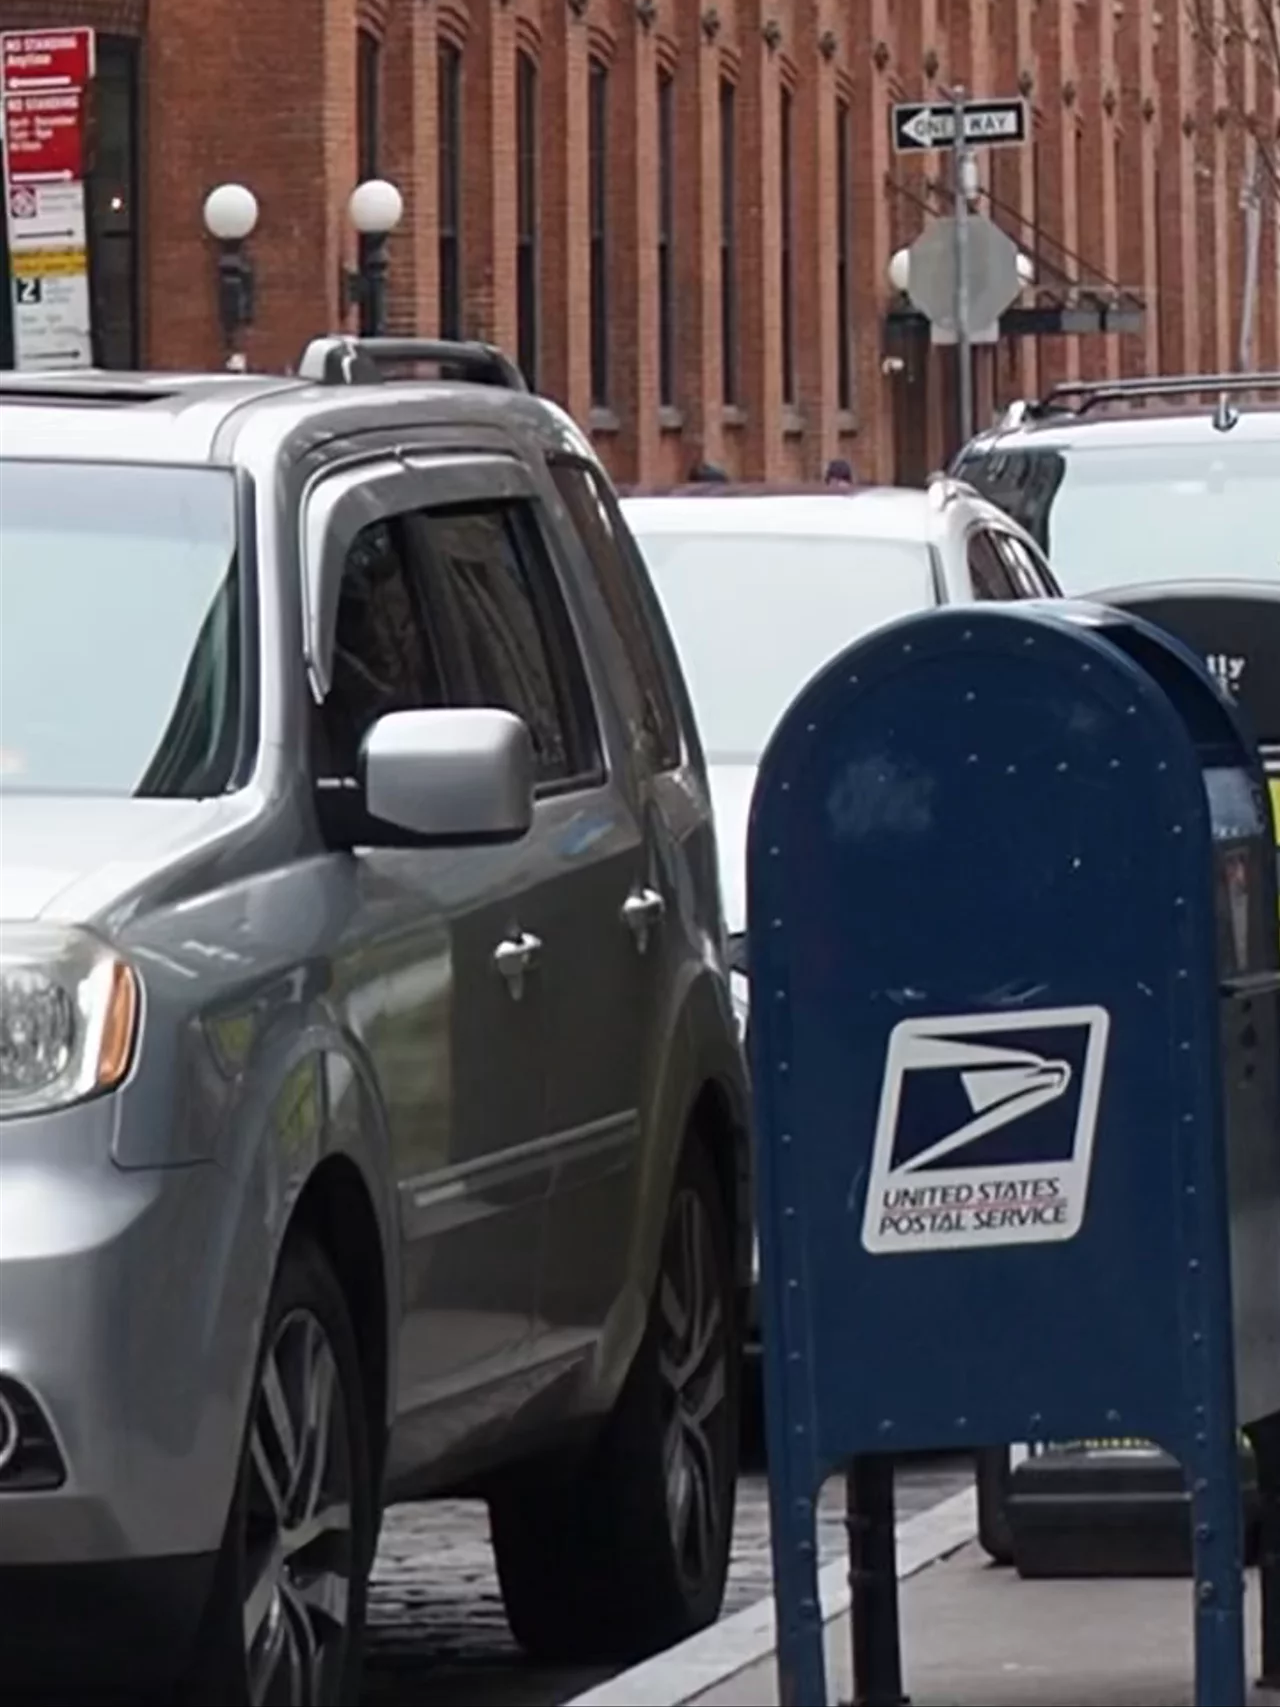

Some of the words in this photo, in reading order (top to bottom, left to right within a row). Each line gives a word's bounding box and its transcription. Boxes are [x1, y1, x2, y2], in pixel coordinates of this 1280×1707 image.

[969, 114, 1009, 132] WAY
[883, 1183, 973, 1210] UNITED
[978, 1177, 1060, 1202] STATES
[878, 1211, 967, 1237] POSTAL
[973, 1205, 1067, 1231] SERVICE
